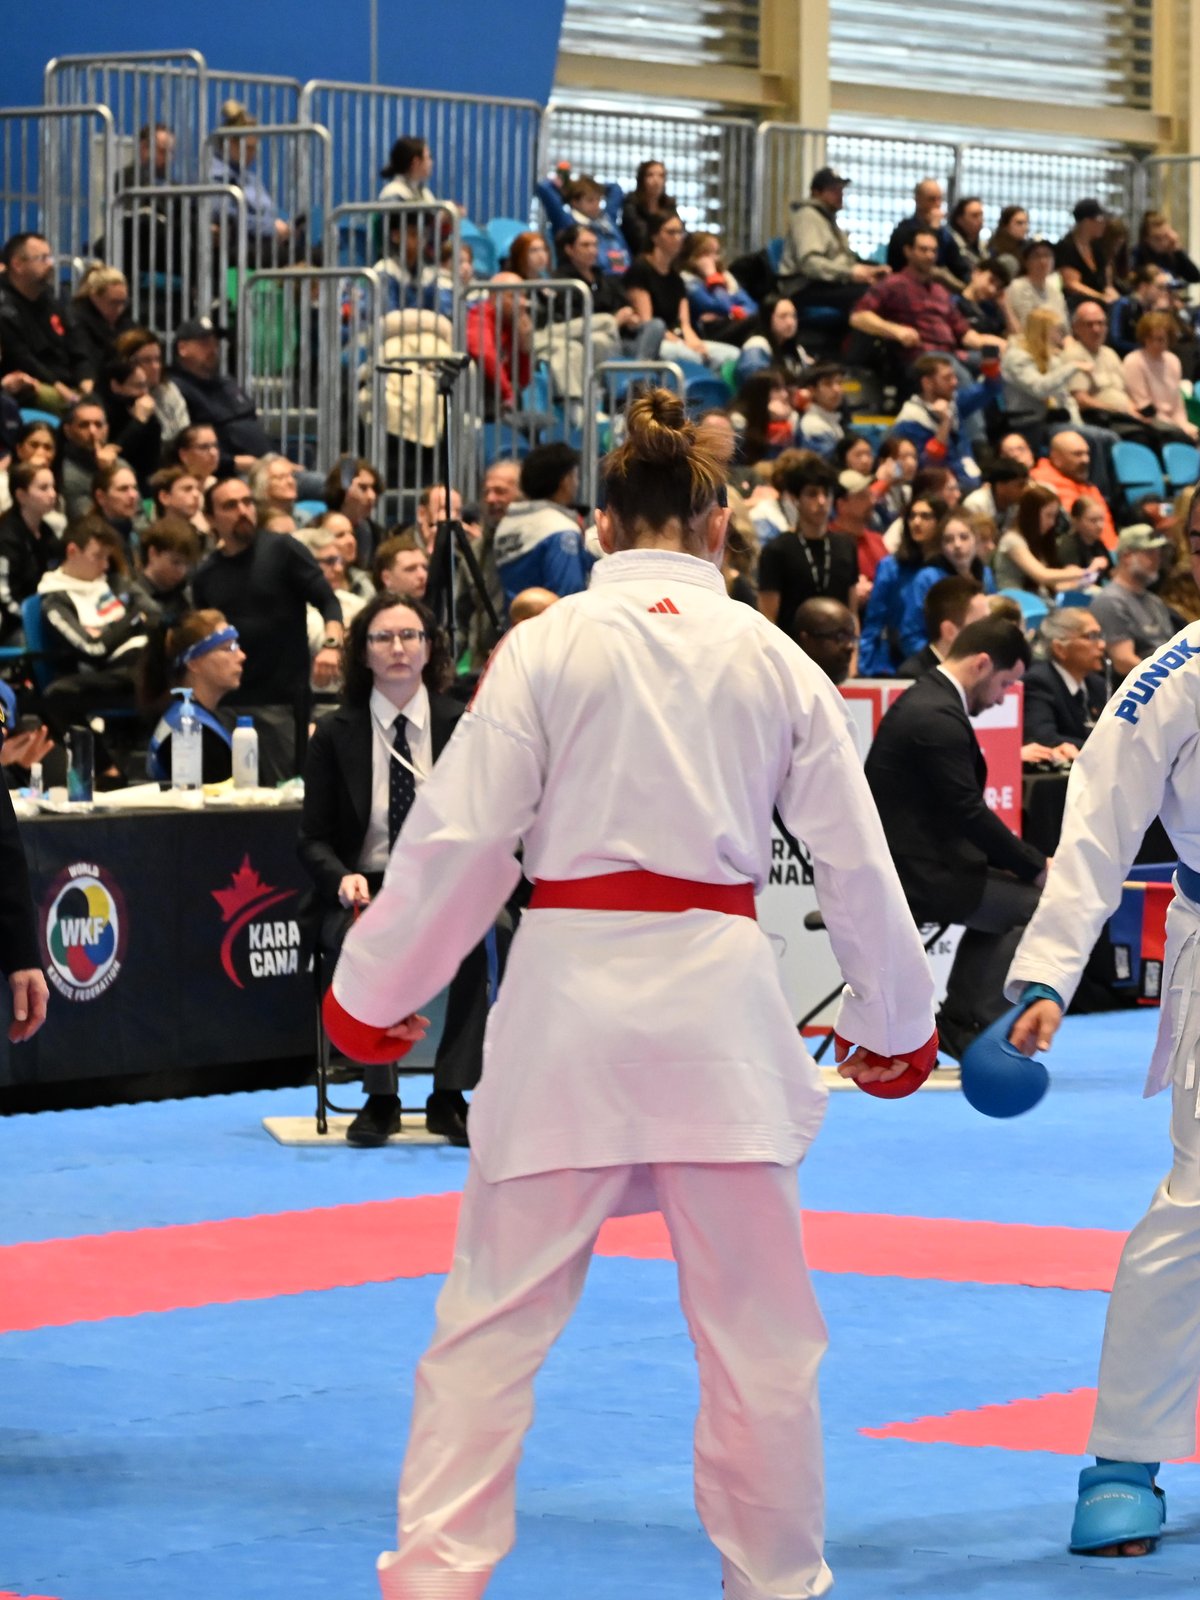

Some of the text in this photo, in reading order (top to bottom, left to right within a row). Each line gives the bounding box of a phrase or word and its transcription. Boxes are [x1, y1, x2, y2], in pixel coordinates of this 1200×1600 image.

[60, 916, 104, 947] WKF
[249, 920, 300, 949] KARA
[249, 949, 298, 978] CANA
